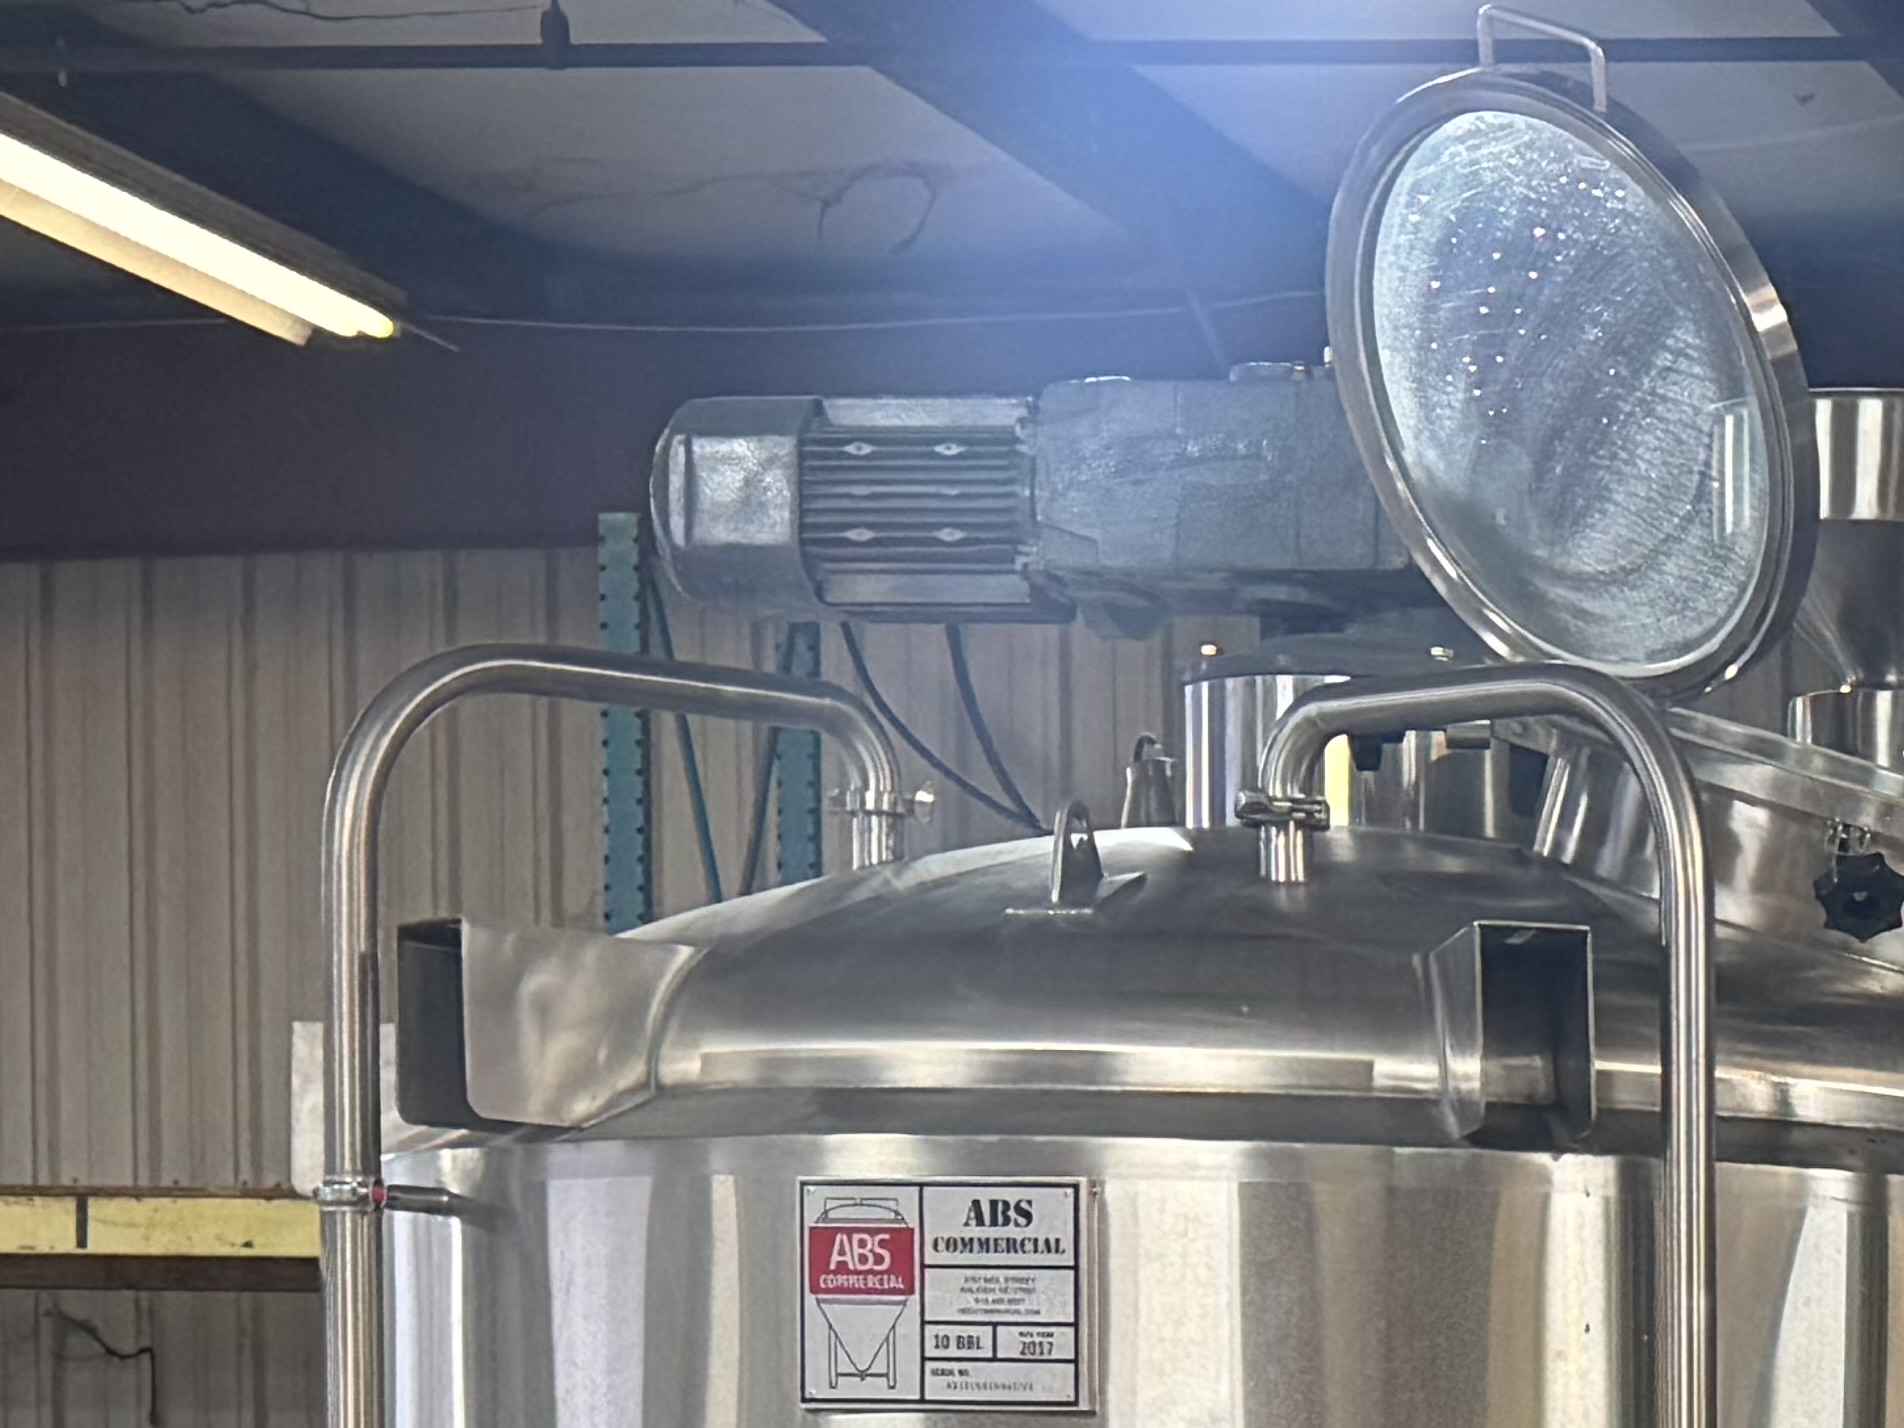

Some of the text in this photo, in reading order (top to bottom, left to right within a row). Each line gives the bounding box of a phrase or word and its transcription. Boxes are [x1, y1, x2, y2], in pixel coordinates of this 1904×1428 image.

[963, 1198, 1033, 1228] ABS
[829, 1233, 892, 1271] ABS
[932, 1236, 1066, 1255] COMMERCIAL
[933, 1333, 984, 1351] 10 BBL
[1019, 1340, 1054, 1356] 2017
